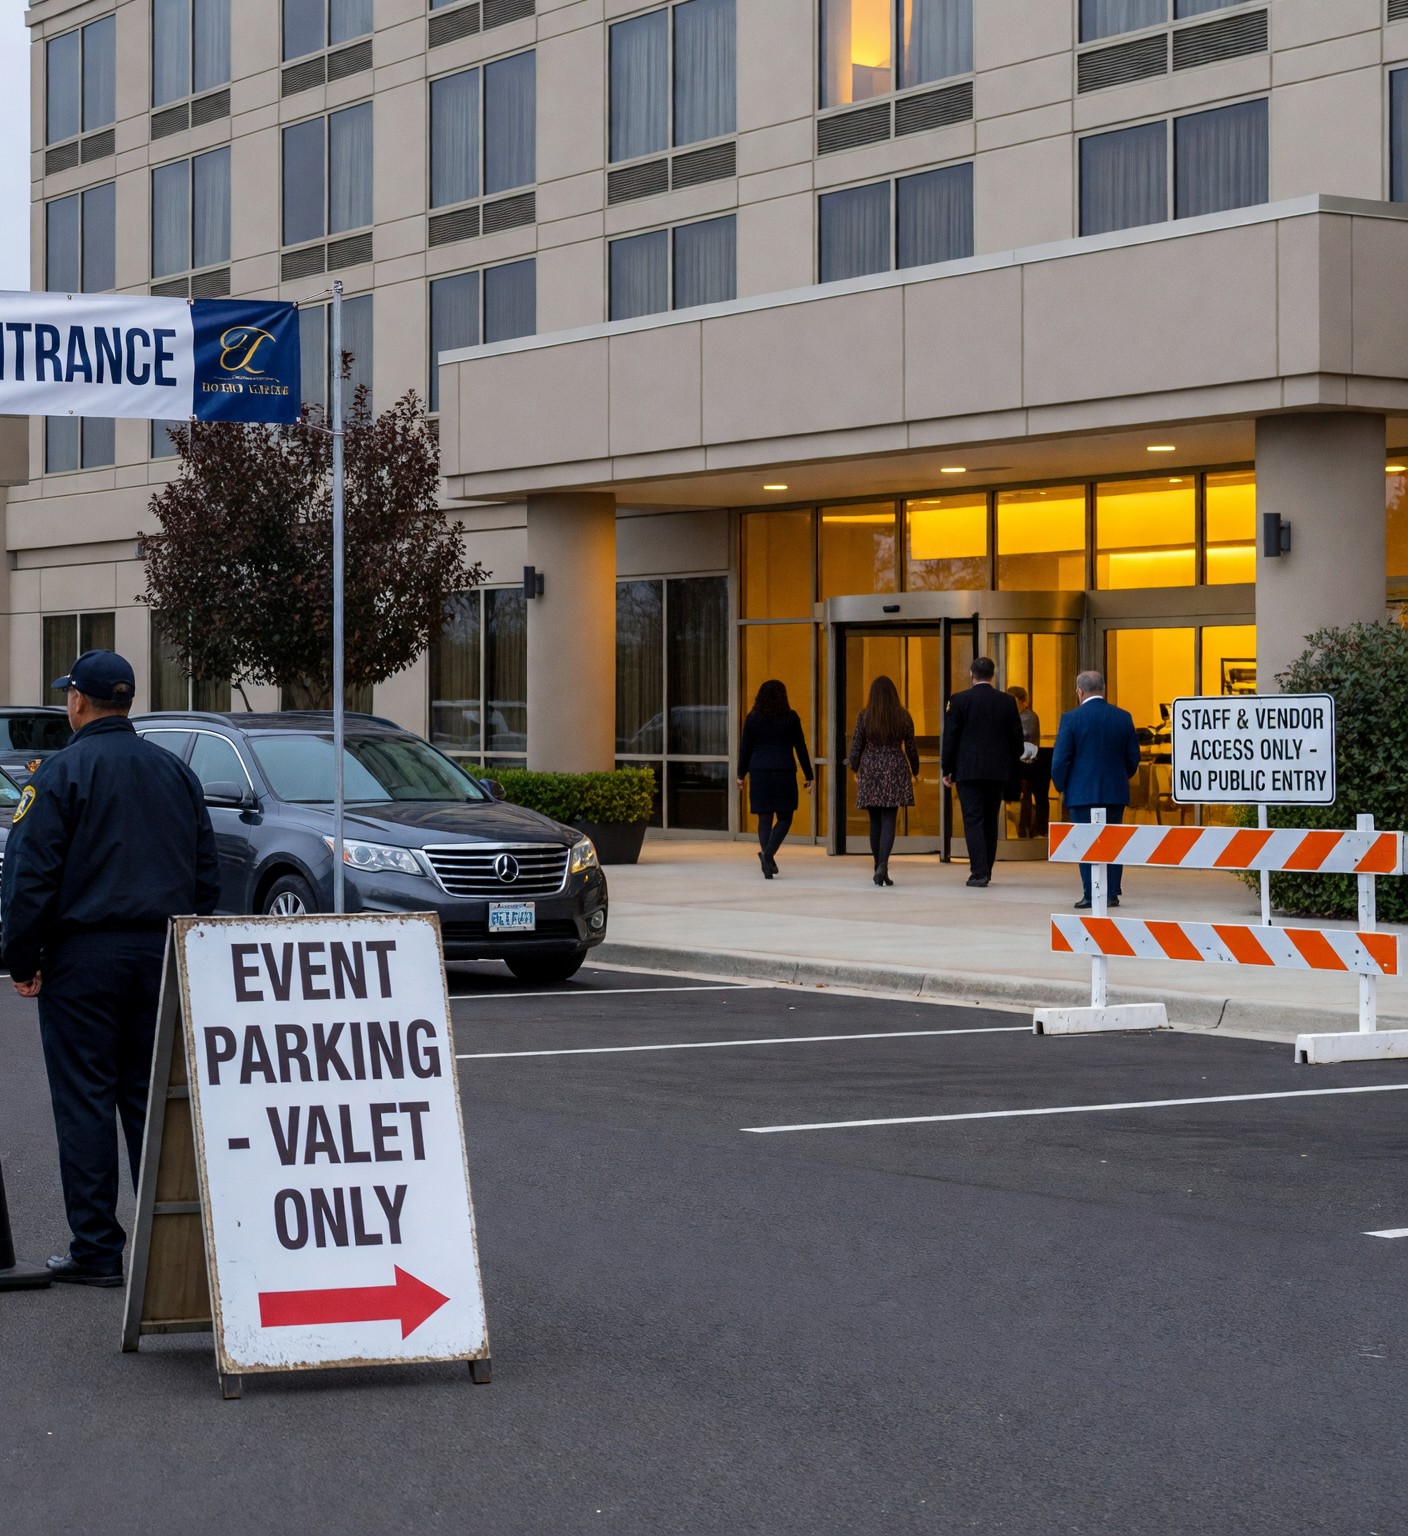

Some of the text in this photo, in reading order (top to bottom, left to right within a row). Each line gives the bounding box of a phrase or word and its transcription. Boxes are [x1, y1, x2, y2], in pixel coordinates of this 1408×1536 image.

[1181, 707, 1324, 730] STAFF & VENDOR
[1190, 738, 1254, 761] ACCESS
[1260, 738, 1303, 761] ONLY
[1179, 769, 1327, 792] NO PUBLIC ENTRY
[230, 939, 397, 1003] EVENT
[203, 1018, 442, 1086] PARKING
[228, 1101, 431, 1166] - VALET
[273, 1184, 408, 1251] ONLY
